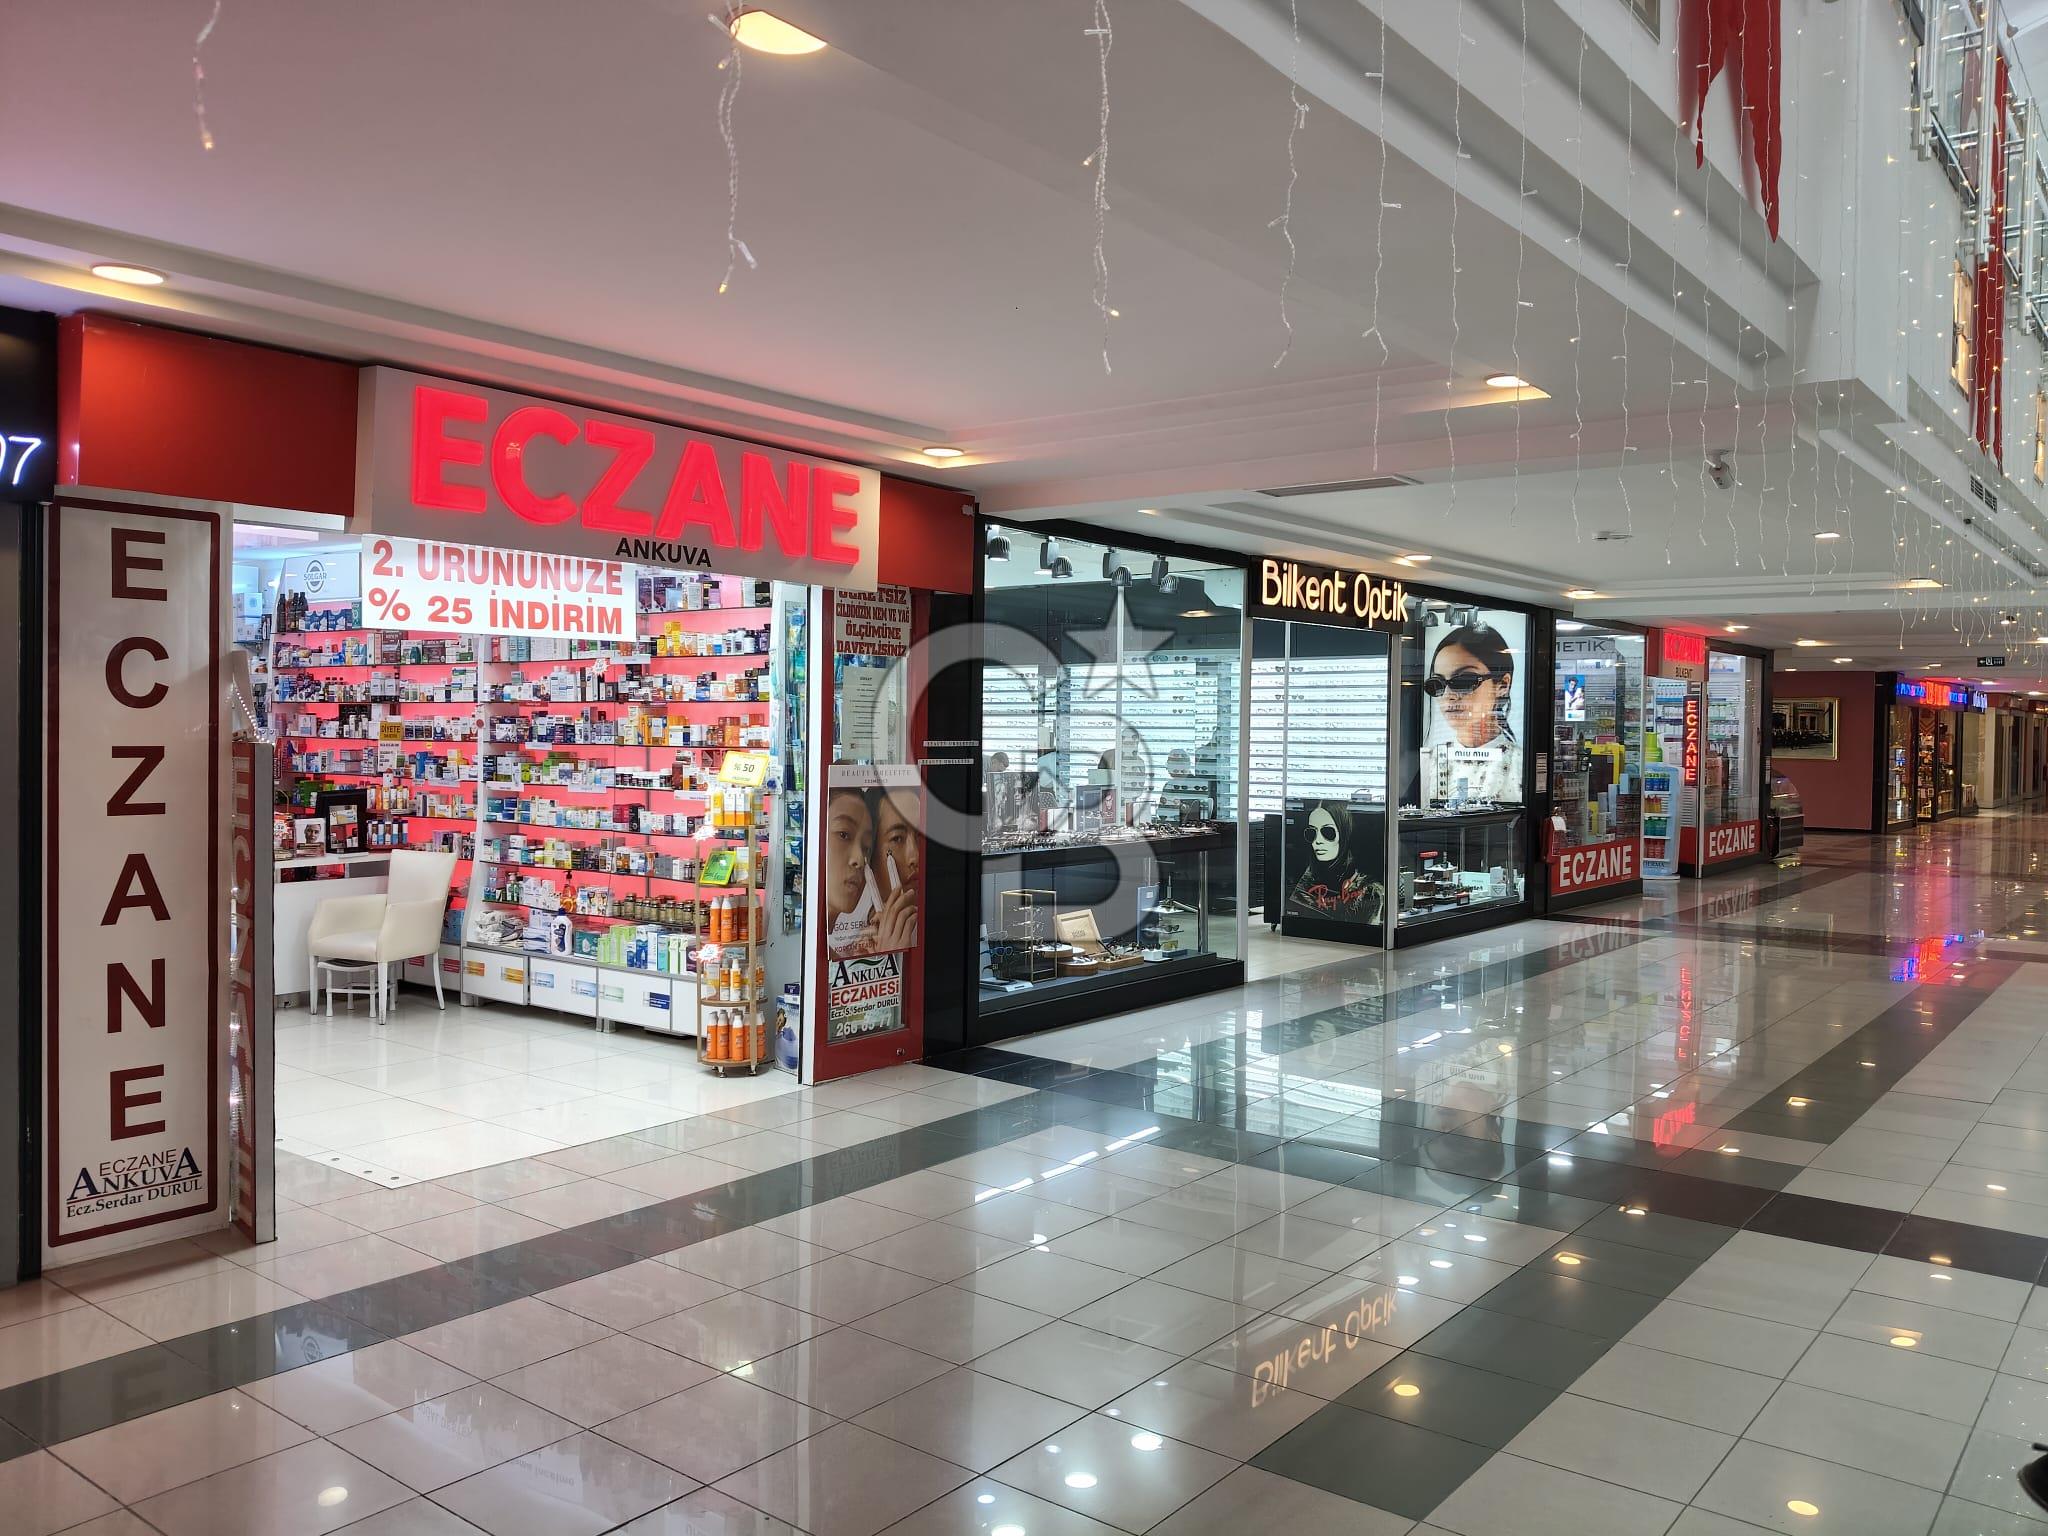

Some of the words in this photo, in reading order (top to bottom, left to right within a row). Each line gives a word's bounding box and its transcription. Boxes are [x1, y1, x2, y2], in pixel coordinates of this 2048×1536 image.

[0, 434, 41, 485] 7
[412, 385, 860, 566] ECZANE
[372, 540, 404, 577] 2.
[615, 537, 712, 568] ANKUVA
[1262, 559, 1347, 613] Bilkent
[1354, 572, 1409, 628] Optik
[427, 595, 473, 625] 25
[489, 590, 623, 635] İNDİRİM
[846, 620, 901, 639] ÖLÇÜMÜNE
[888, 607, 897, 622] VE
[836, 640, 907, 657] DAVETLİSİNİZ
[1686, 701, 1698, 781] ECZANE
[743, 764, 754, 772] 50
[101, 528, 170, 1141] ECZANE
[1709, 825, 1755, 857] ECZANE
[1560, 845, 1632, 887] ECZANE
[831, 953, 899, 988] ANKUVA
[853, 1003, 875, 1015] Serdar
[877, 998, 899, 1009] DURUL
[66, 1147, 202, 1200] ANKUVA
[100, 1149, 177, 1176] ECZANE
[147, 1179, 203, 1200] DURUL
